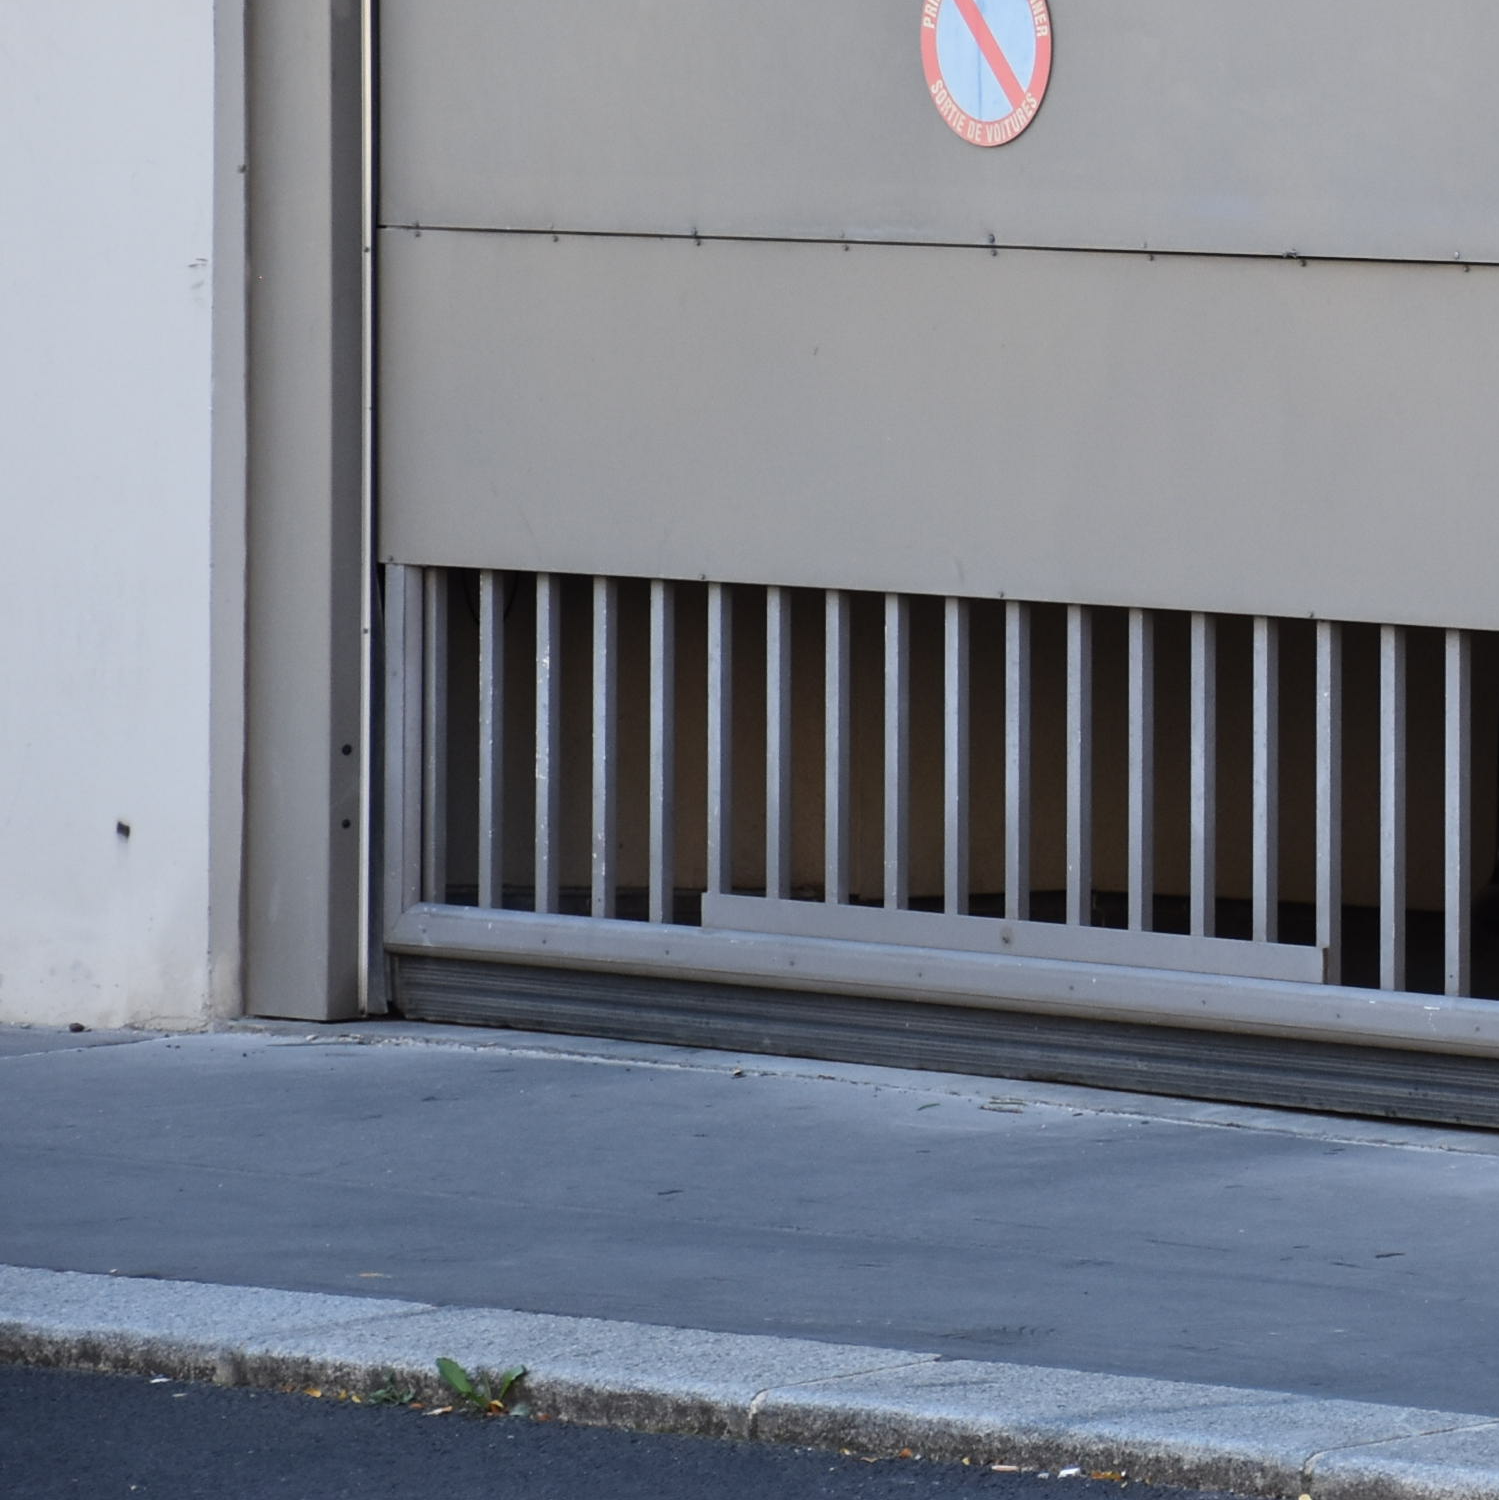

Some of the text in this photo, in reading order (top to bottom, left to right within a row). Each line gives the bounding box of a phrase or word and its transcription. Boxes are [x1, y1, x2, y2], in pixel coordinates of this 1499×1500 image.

[930, 79, 1038, 143] SORTIE DE VOITURES
